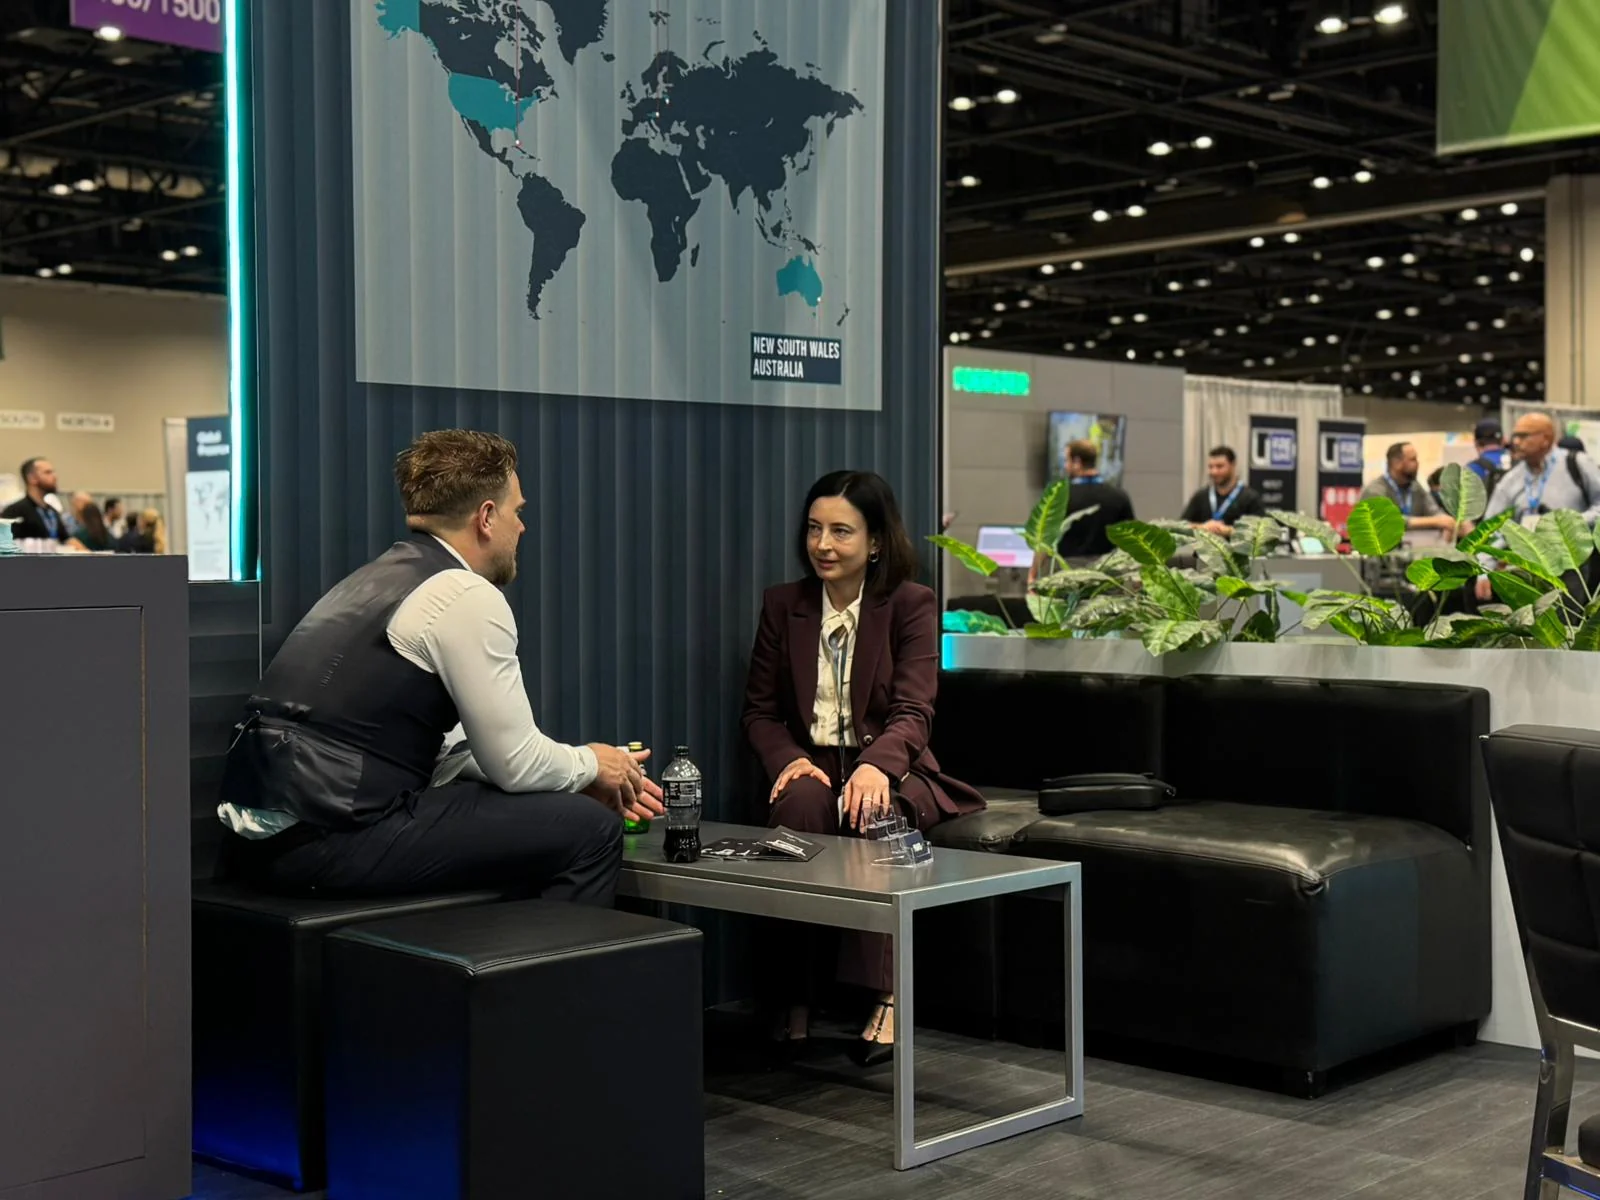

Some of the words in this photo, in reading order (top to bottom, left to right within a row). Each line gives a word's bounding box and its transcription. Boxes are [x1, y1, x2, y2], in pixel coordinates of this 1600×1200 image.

[753, 336, 775, 354] NEW
[777, 338, 807, 357] SOUTH
[809, 340, 840, 359] WALES
[753, 358, 804, 378] AUSTRALIA
